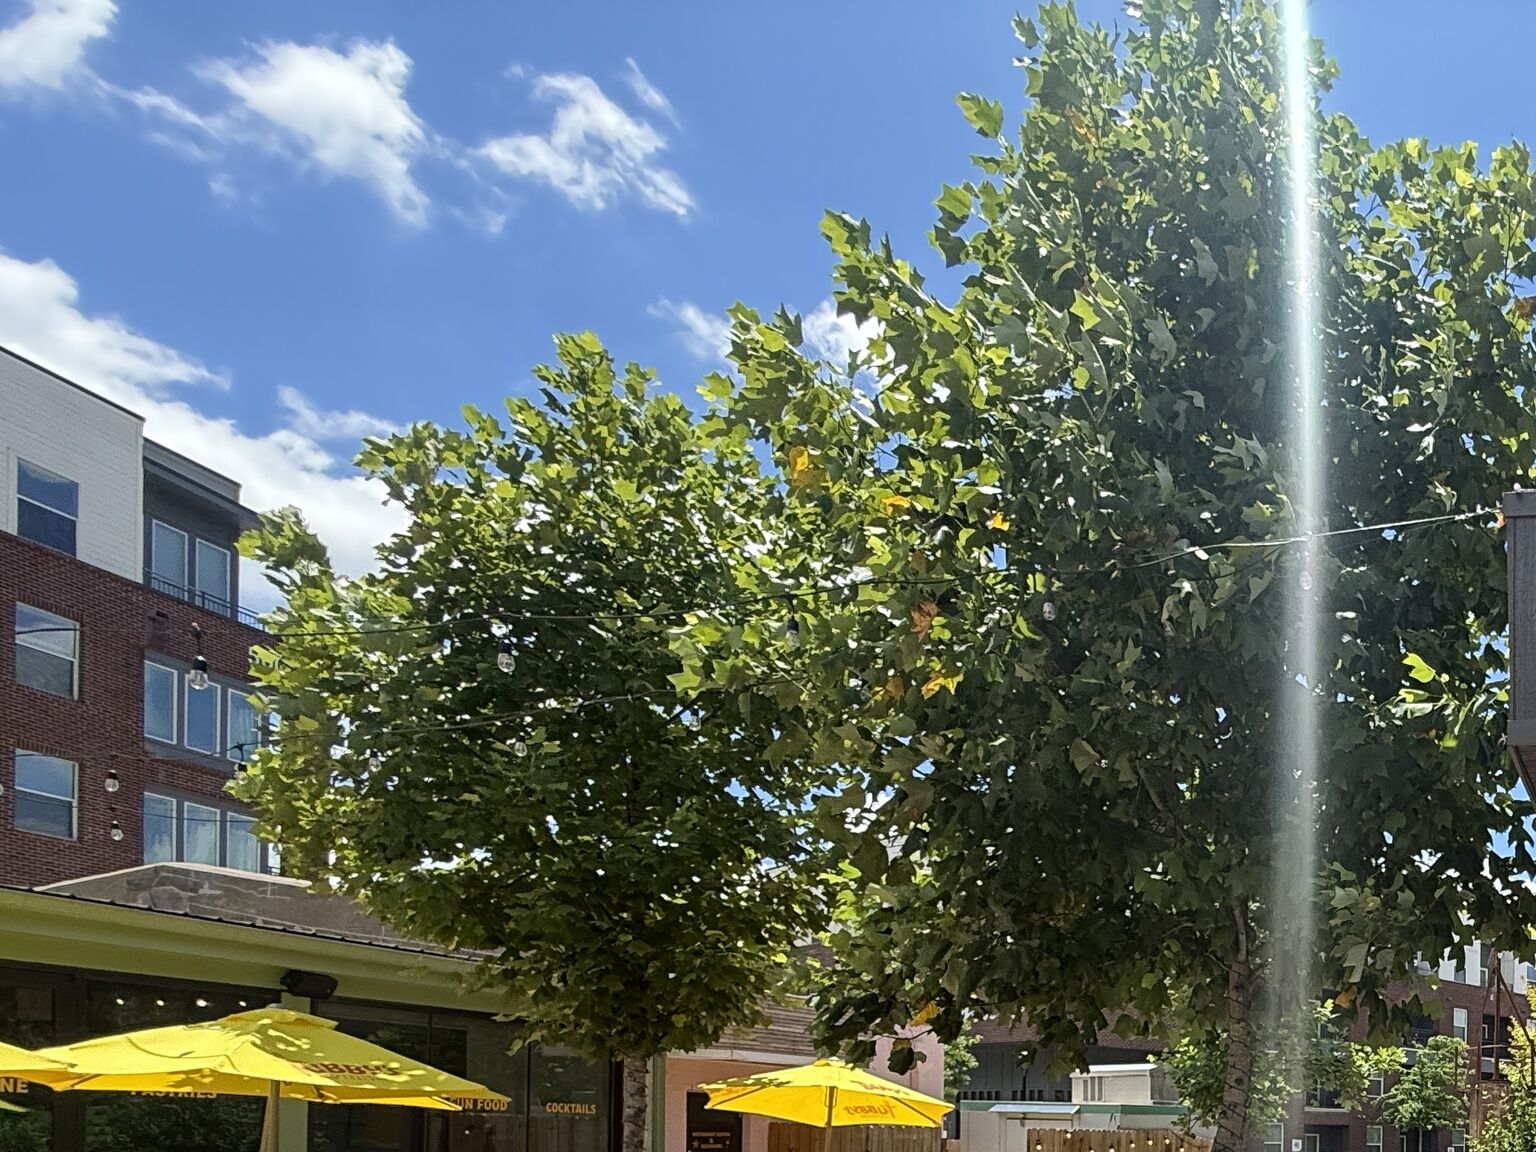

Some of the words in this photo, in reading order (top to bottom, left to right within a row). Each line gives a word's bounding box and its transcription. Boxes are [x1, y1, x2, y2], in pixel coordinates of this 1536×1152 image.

[0, 1077, 29, 1094] NE
[477, 1099, 508, 1111] FOOD
[545, 1102, 596, 1114] COCKTAILS
